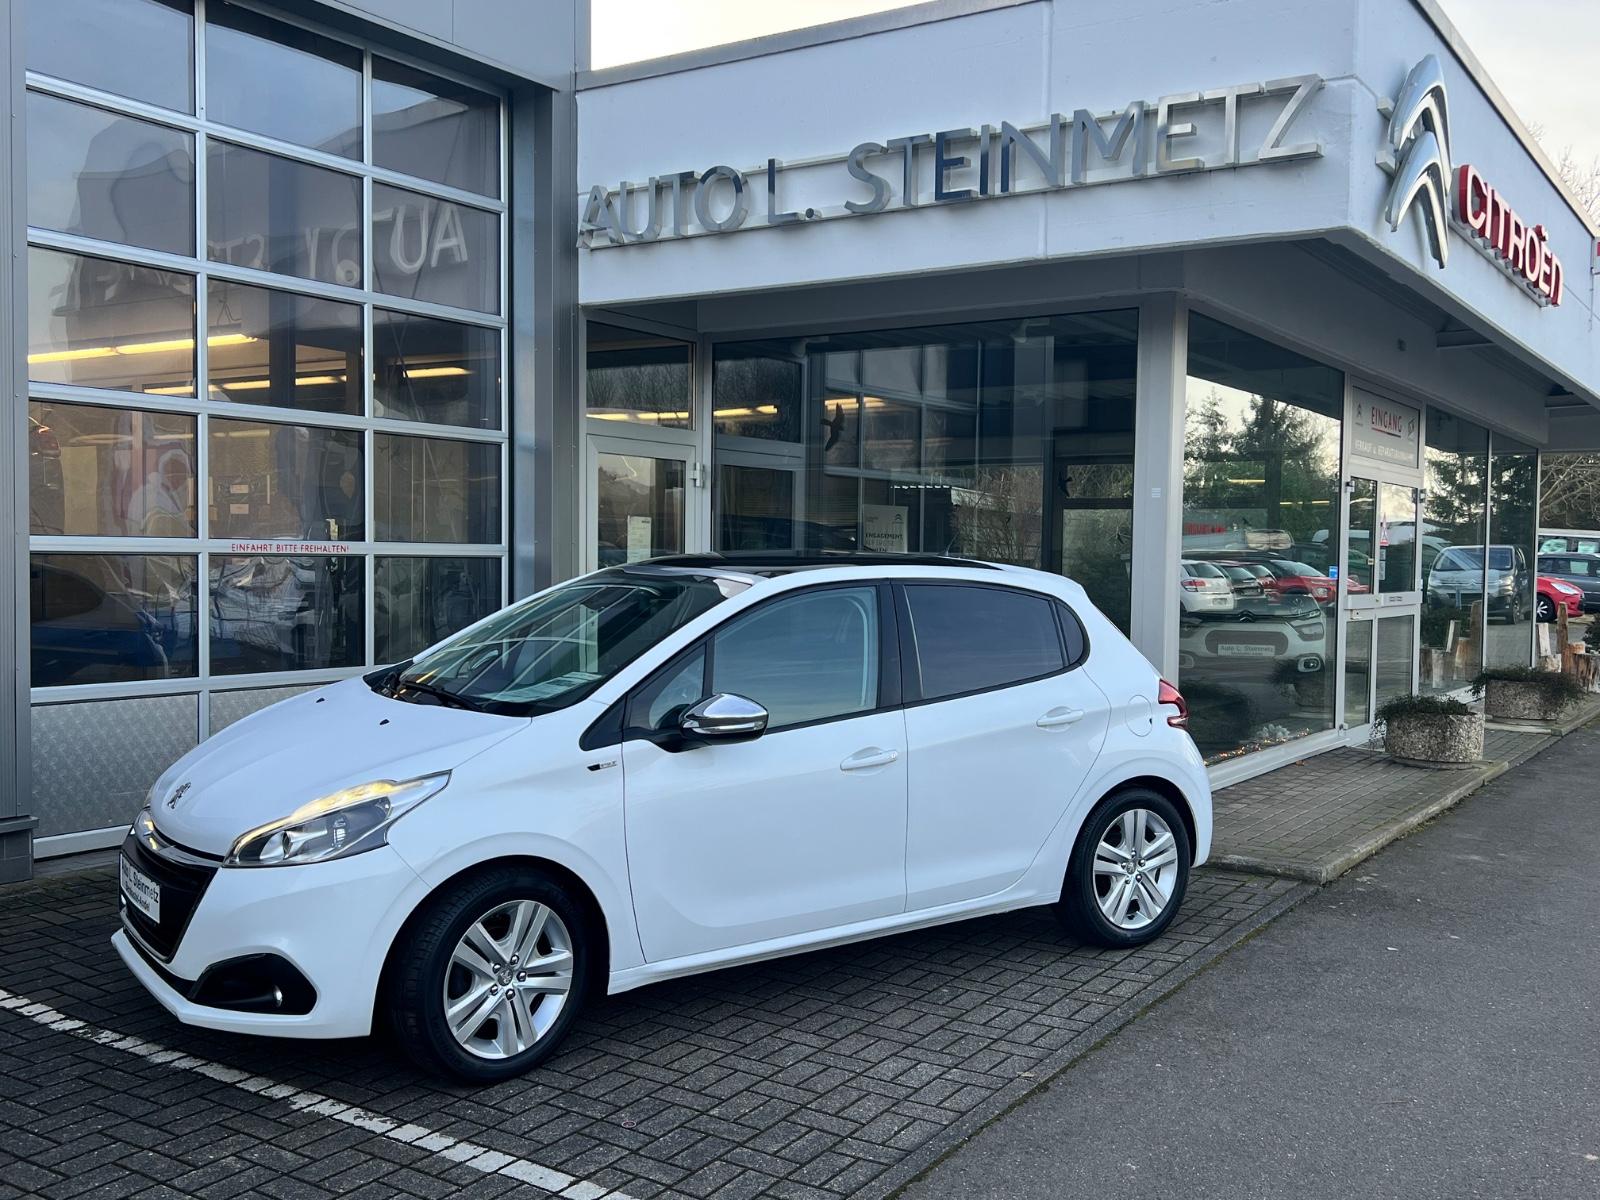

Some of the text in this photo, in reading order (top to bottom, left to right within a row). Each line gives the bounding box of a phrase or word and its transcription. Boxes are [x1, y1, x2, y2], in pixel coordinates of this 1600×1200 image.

[577, 73, 1325, 249] AUTO L. STEINMETZ
[1458, 164, 1564, 307] CITROËN
[1371, 407, 1402, 433] EINGANG
[231, 543, 350, 553] EINFAHRT BITTE FREIHALTEN!
